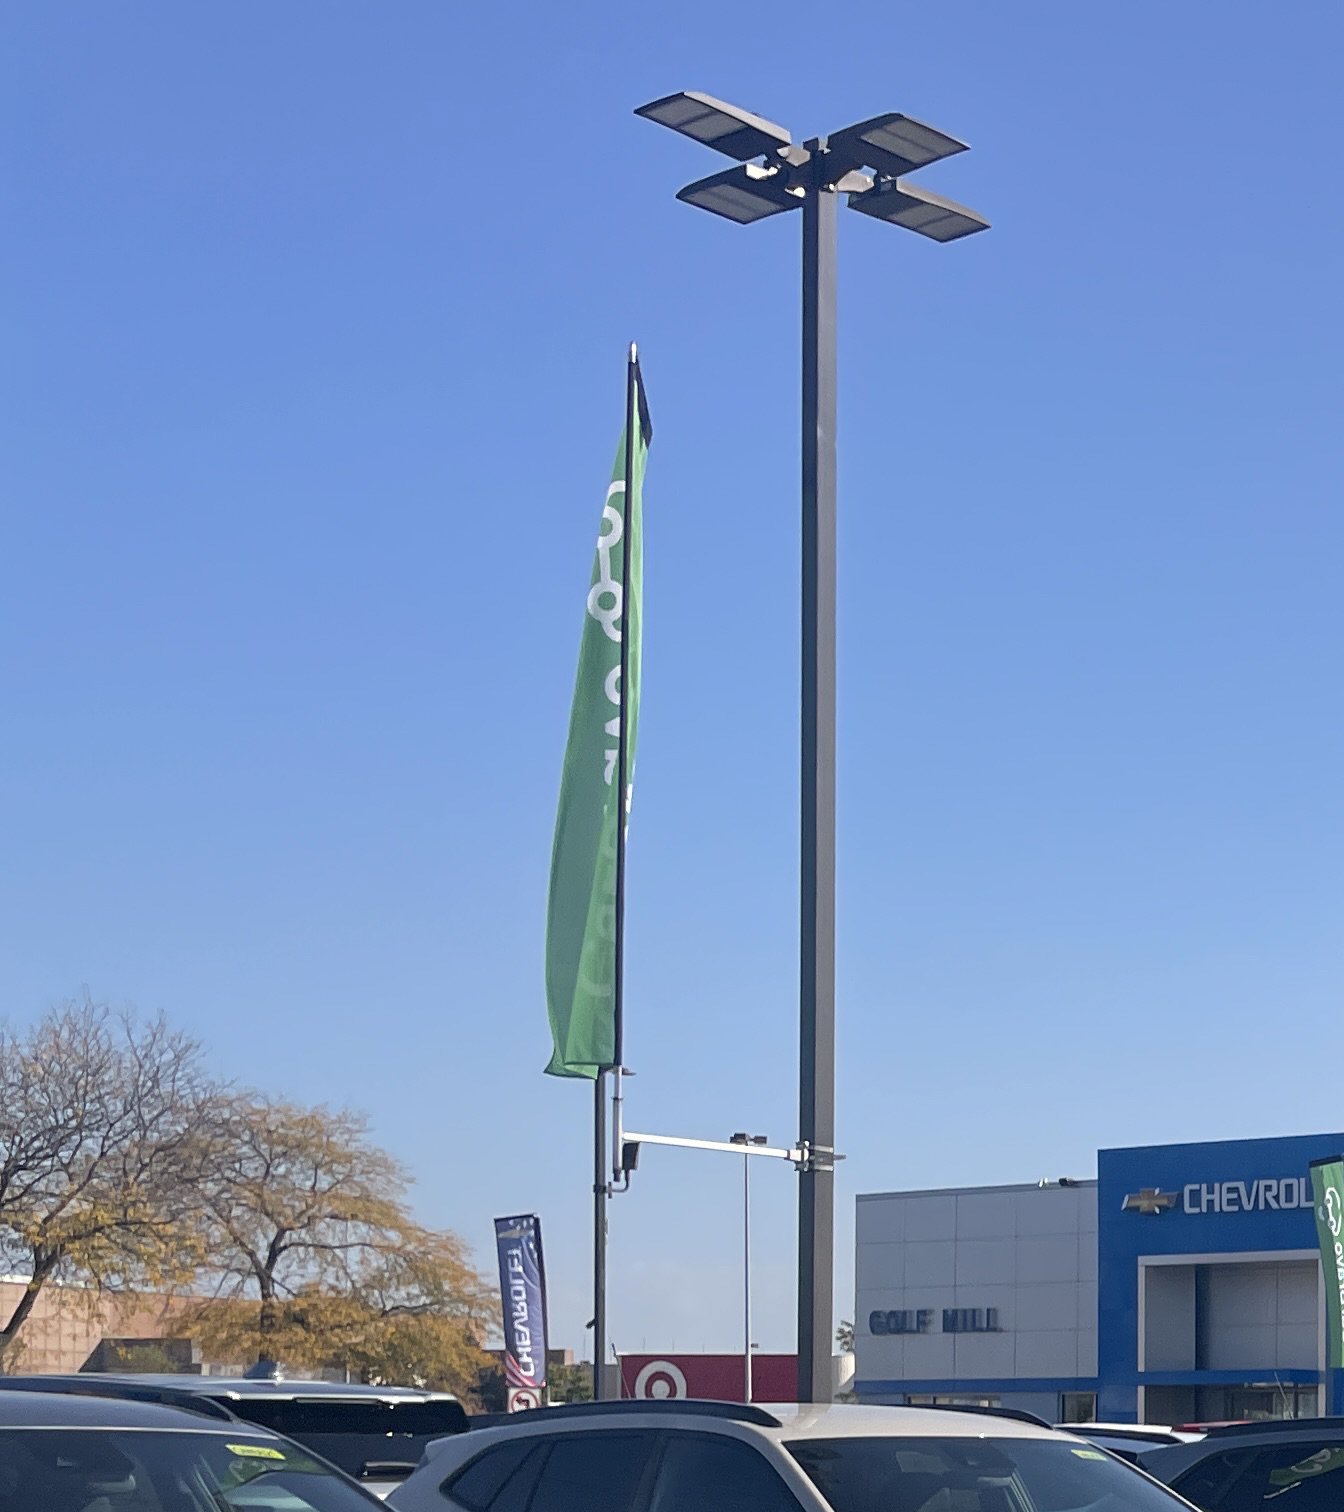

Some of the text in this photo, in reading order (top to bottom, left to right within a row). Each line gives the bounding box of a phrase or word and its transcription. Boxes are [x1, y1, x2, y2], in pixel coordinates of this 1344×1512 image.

[1183, 1177, 1314, 1214] CHEVROL
[869, 1307, 1003, 1335] GOLF MILL
